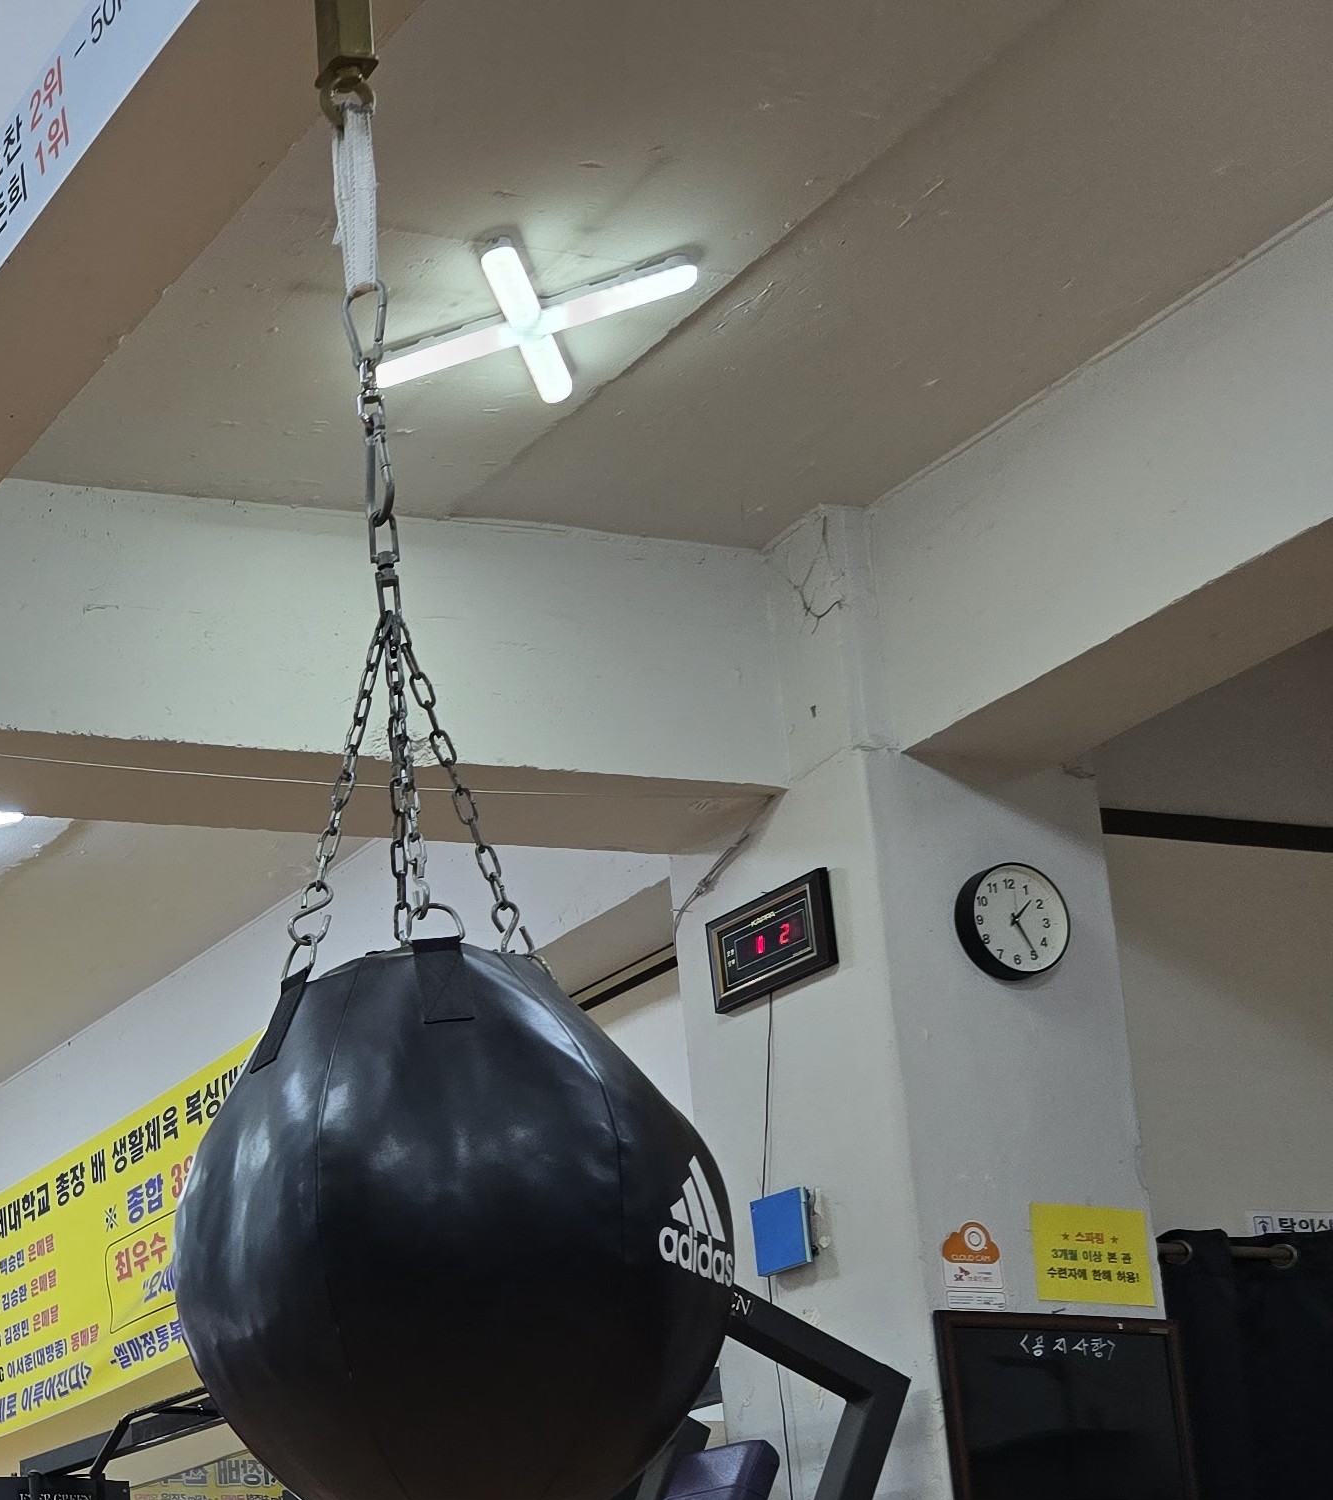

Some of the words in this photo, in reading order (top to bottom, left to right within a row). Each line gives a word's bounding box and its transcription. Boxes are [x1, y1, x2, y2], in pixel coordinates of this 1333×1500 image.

[29, 55, 64, 132] 2위
[35, 105, 69, 176] 1위
[986, 882, 998, 894] 11
[1002, 878, 1015, 890] 12
[1022, 884, 1029, 896] 1
[976, 895, 988, 907] 10
[1035, 898, 1044, 910] 2
[975, 914, 984, 926] 9
[1042, 917, 1051, 929] 3
[982, 933, 991, 945] 8
[1040, 936, 1048, 948] 4
[996, 948, 1004, 960] 7
[1013, 953, 1022, 965] 6
[1030, 949, 1039, 961] 5
[55, 1161, 85, 1207] 총장
[90, 1148, 107, 1185] 배
[111, 1105, 179, 1174] 생활체육
[186, 1060, 247, 1126] 복싱대
[126, 1173, 164, 1225] 종합
[28, 1233, 55, 1263] 은메달
[113, 1231, 168, 1283] 최우수
[658, 1226, 734, 1288] adidas
[30, 1268, 57, 1298] 은메달
[3, 1318, 30, 1346] 김정민
[32, 1303, 59, 1333] 은메달
